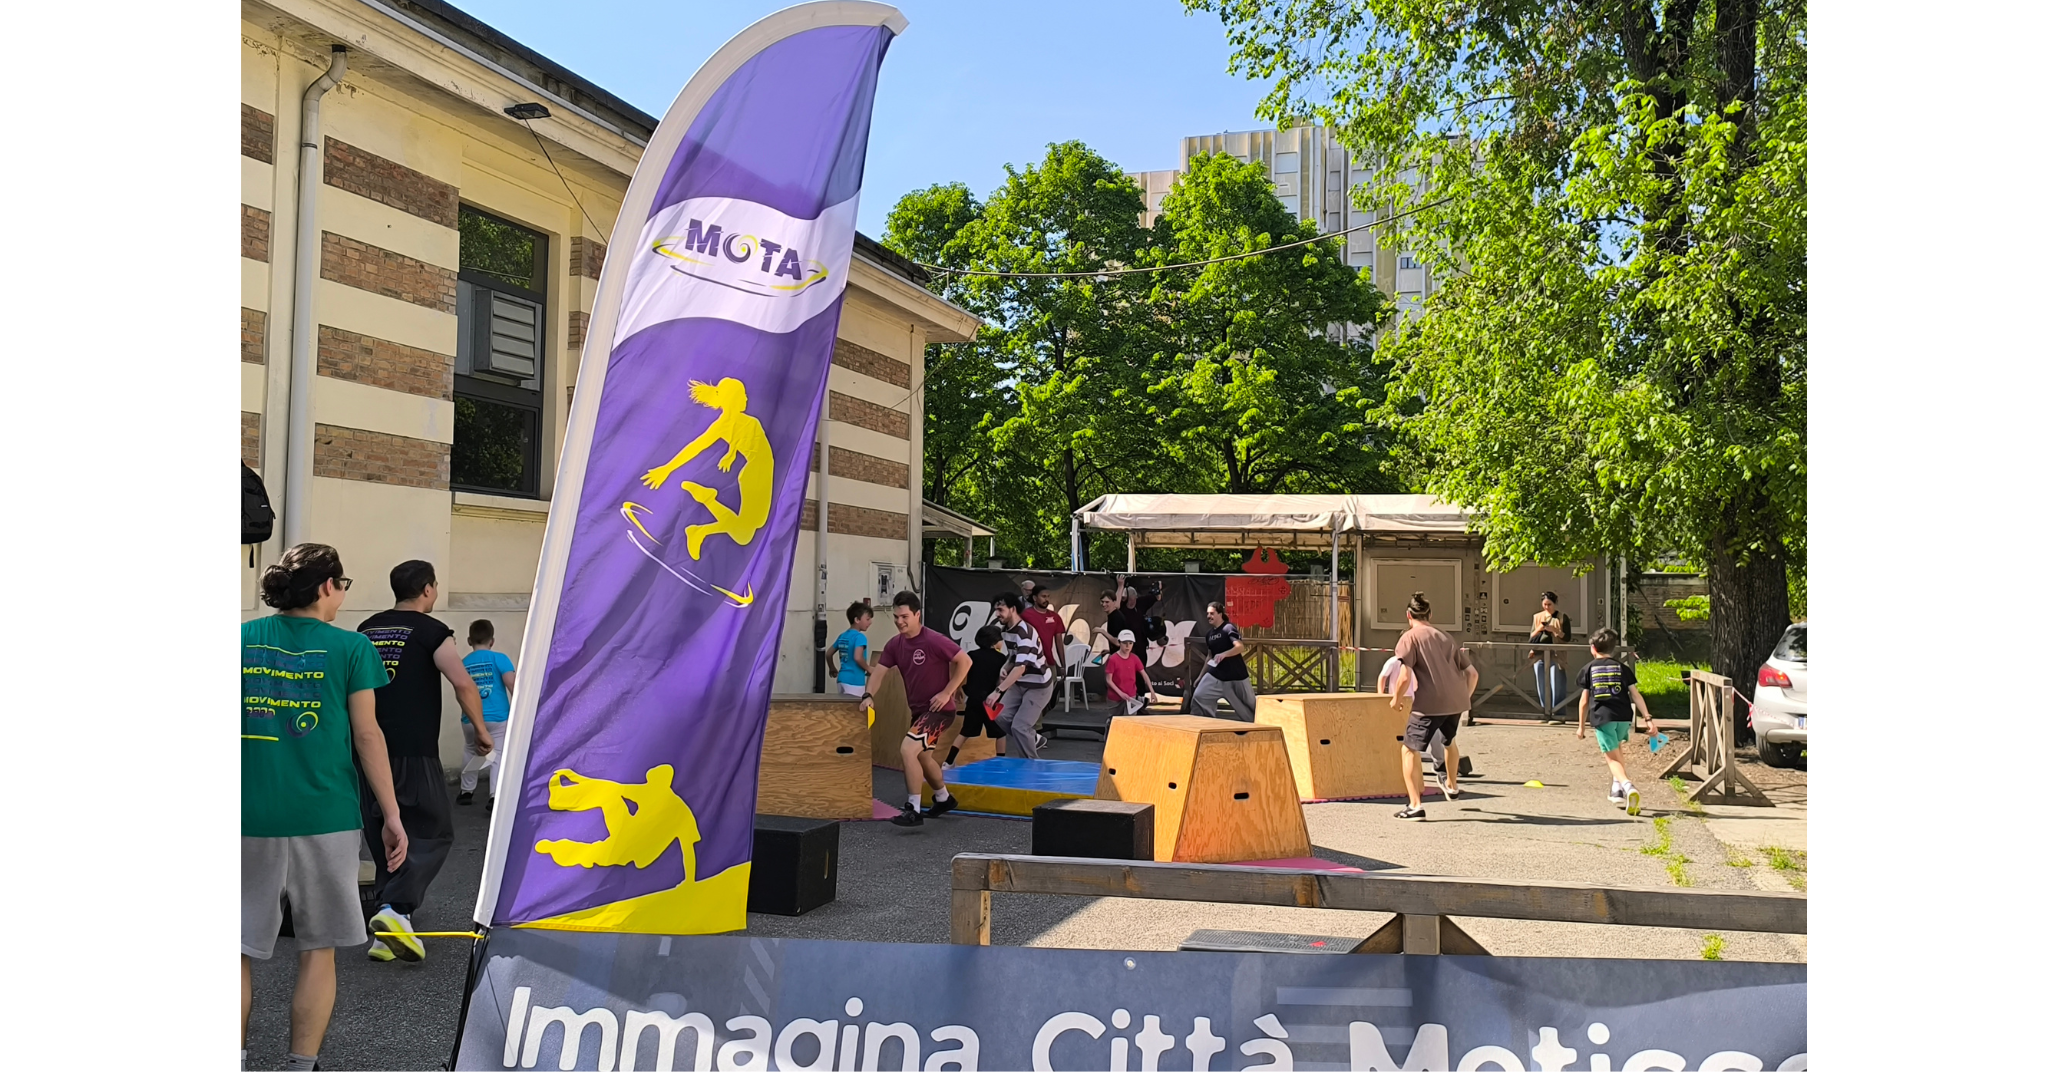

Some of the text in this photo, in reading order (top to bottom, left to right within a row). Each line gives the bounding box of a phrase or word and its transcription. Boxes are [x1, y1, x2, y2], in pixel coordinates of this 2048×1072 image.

[685, 218, 802, 280] MOTA
[243, 667, 325, 680] MOVIMENTO
[502, 986, 980, 1072] Immagina
[1031, 1008, 1294, 1072] Città
